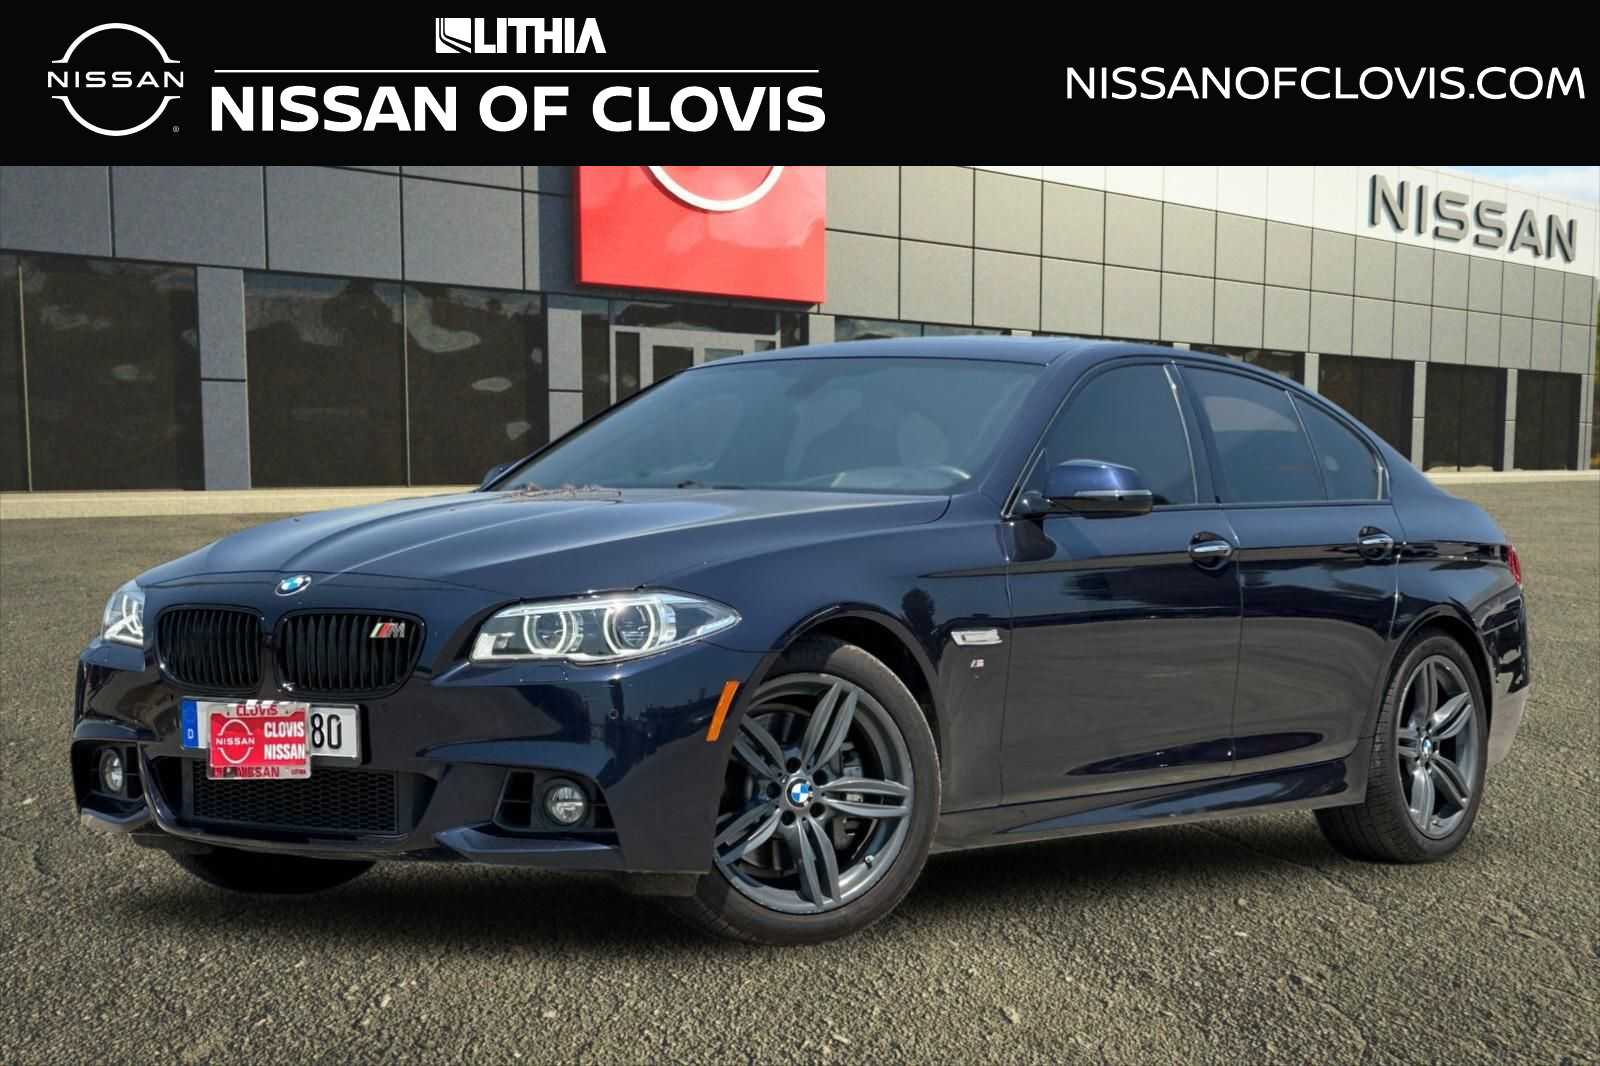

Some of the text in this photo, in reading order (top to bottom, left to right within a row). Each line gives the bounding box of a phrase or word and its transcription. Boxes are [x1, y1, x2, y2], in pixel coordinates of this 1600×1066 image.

[1368, 173, 1578, 263] NISSAN
[263, 721, 304, 738] CLOVIS
[215, 736, 256, 745] NISSAN
[263, 743, 305, 760] NISSAN
